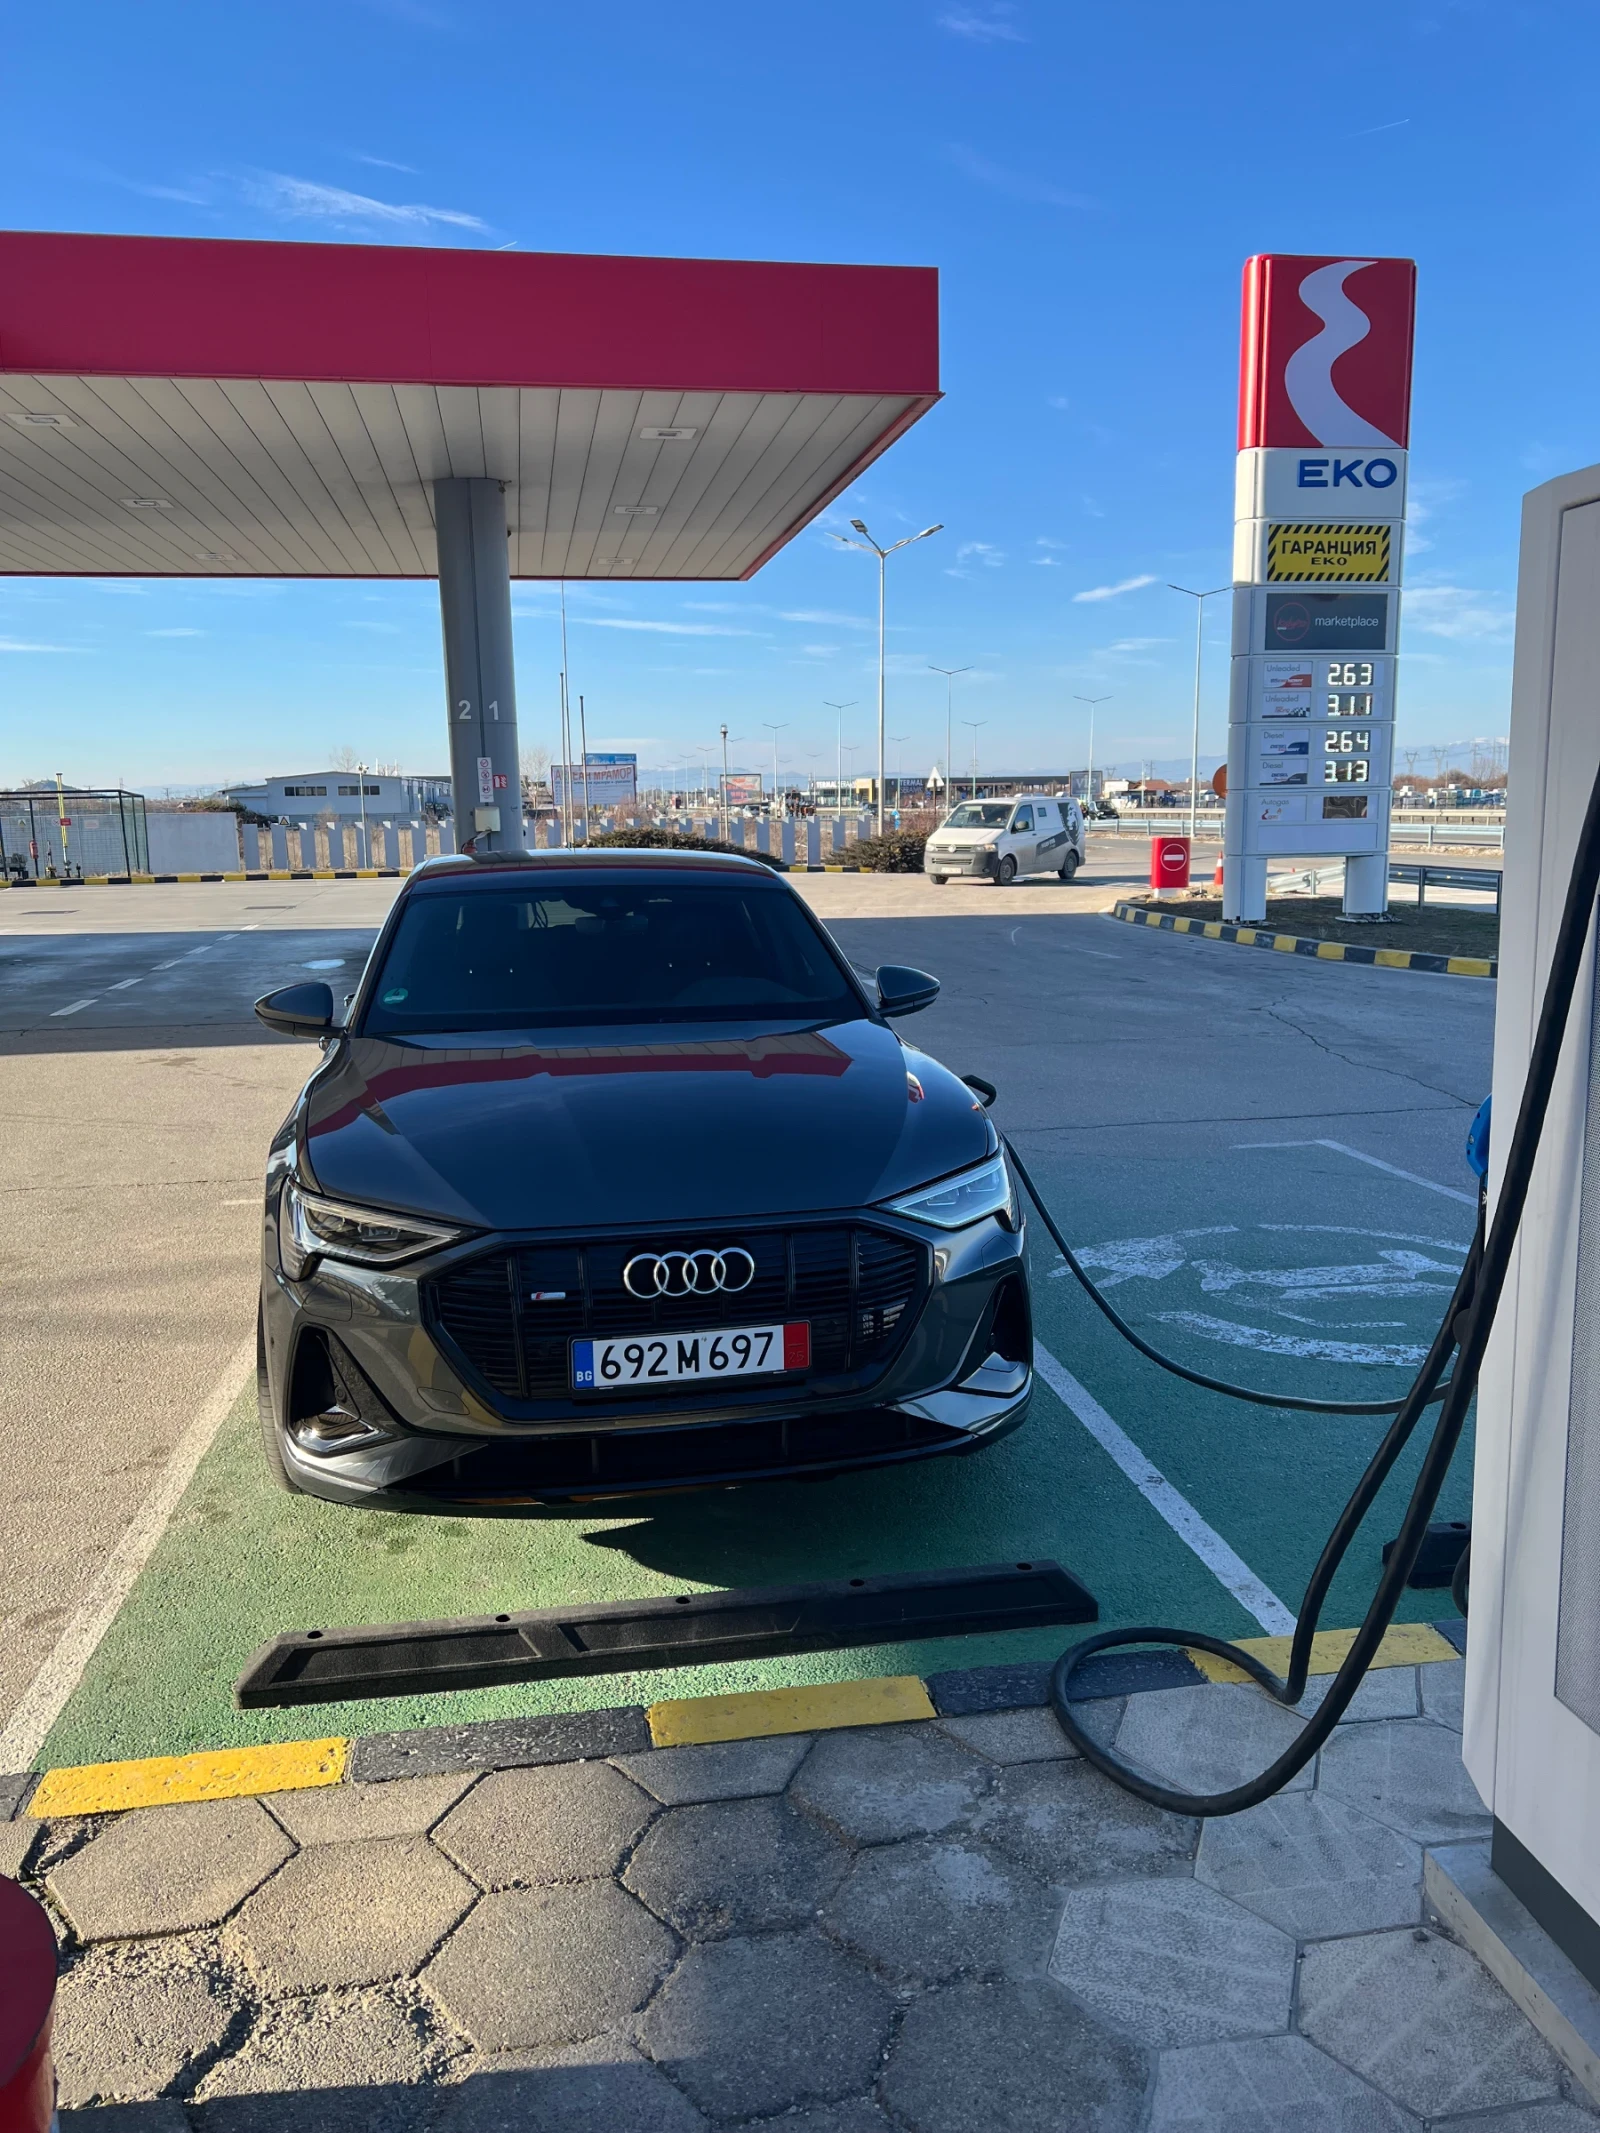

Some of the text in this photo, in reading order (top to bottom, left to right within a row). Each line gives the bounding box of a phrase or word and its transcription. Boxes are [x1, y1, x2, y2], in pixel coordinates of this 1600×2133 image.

[1297, 458, 1397, 488] EKO
[1282, 540, 1376, 556] ГАРАНЦИЯ
[1311, 557, 1347, 565] EKO
[1315, 615, 1379, 628] marketplace
[1266, 664, 1301, 672] Unleaded
[1328, 663, 1372, 686] 2.63
[459, 700, 471, 719] 2
[489, 700, 498, 720] 1
[1263, 731, 1285, 739] Diesel
[1325, 731, 1369, 753] 2.64
[594, 766, 632, 780] МРАМОР
[576, 1370, 592, 1382] BG
